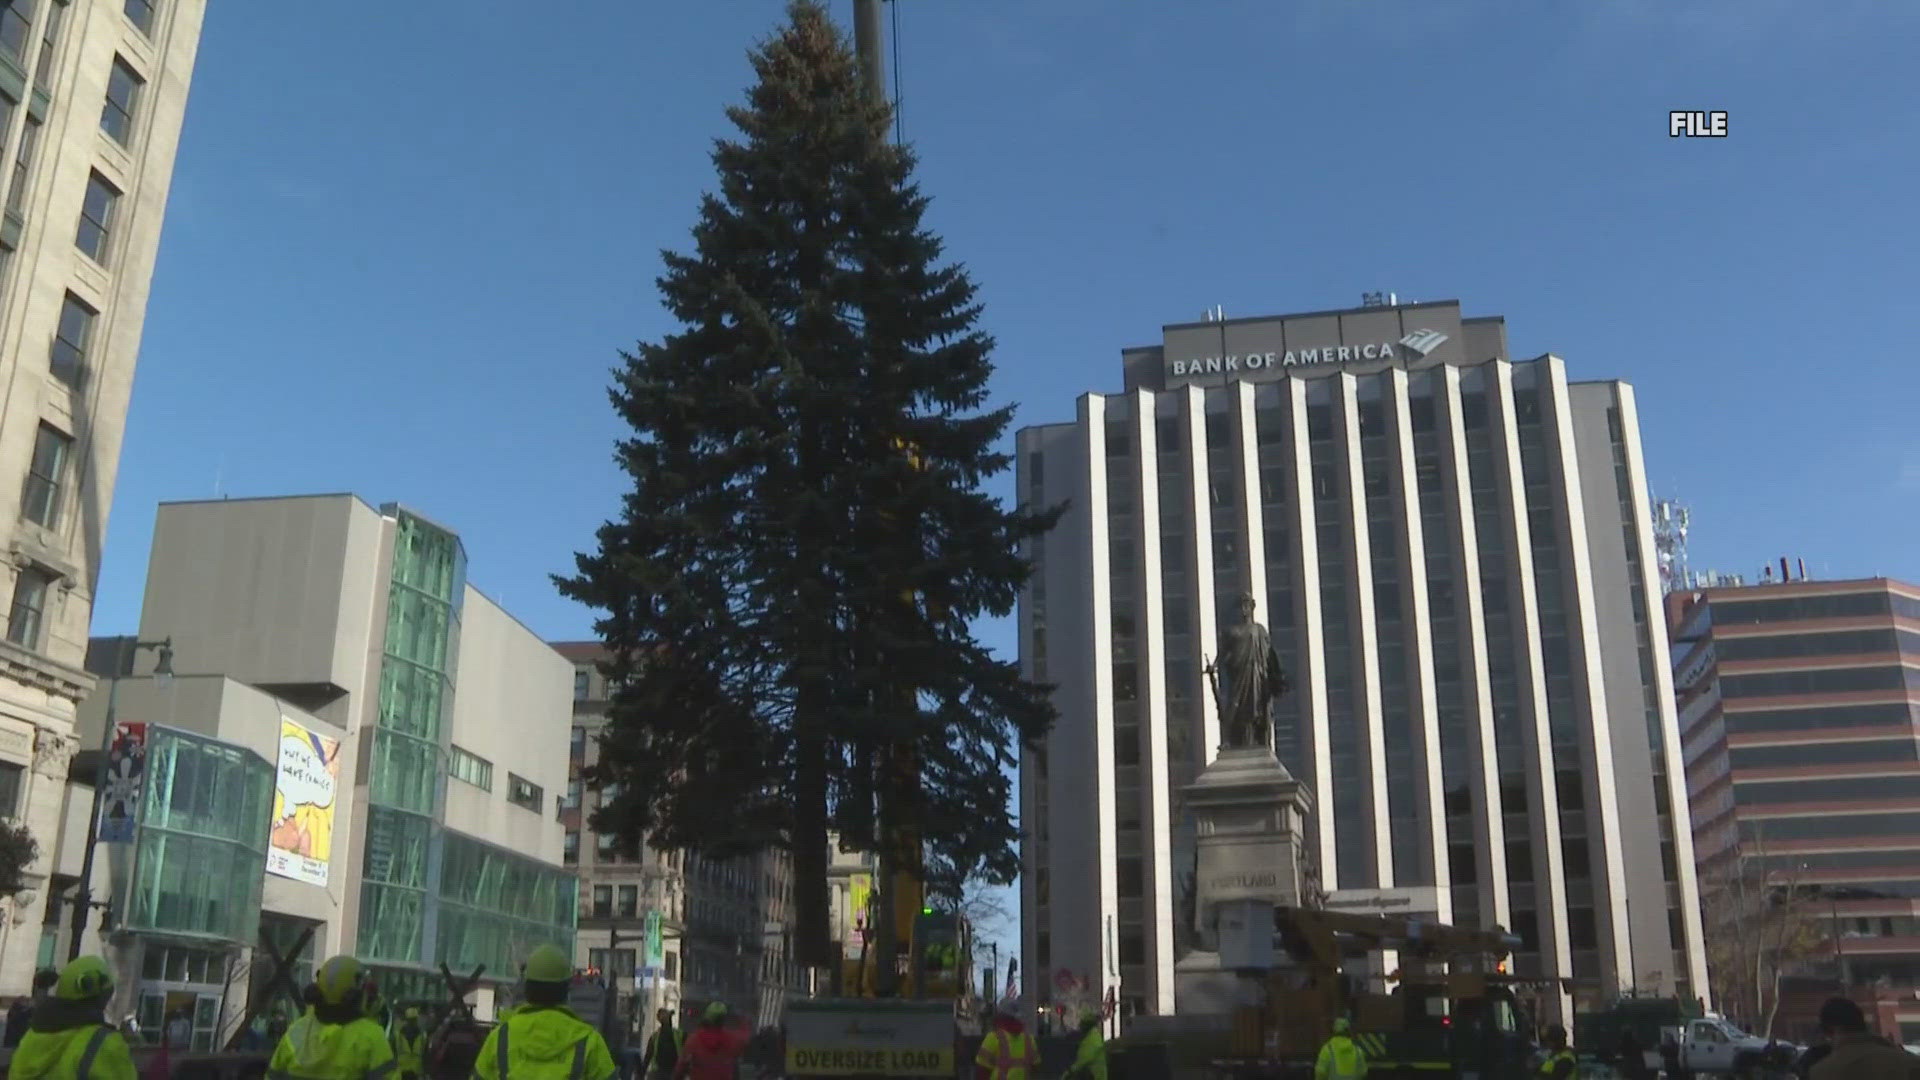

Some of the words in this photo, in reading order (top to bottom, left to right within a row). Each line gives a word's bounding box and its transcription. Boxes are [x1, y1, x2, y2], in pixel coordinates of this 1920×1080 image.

[1173, 355, 1238, 376] BANK
[1246, 351, 1276, 370] OF
[1282, 342, 1394, 367] AMERICA
[1211, 872, 1276, 888] PORTLAND
[795, 1049, 886, 1069] OVERSIZE
[891, 1049, 940, 1069] LOAD
